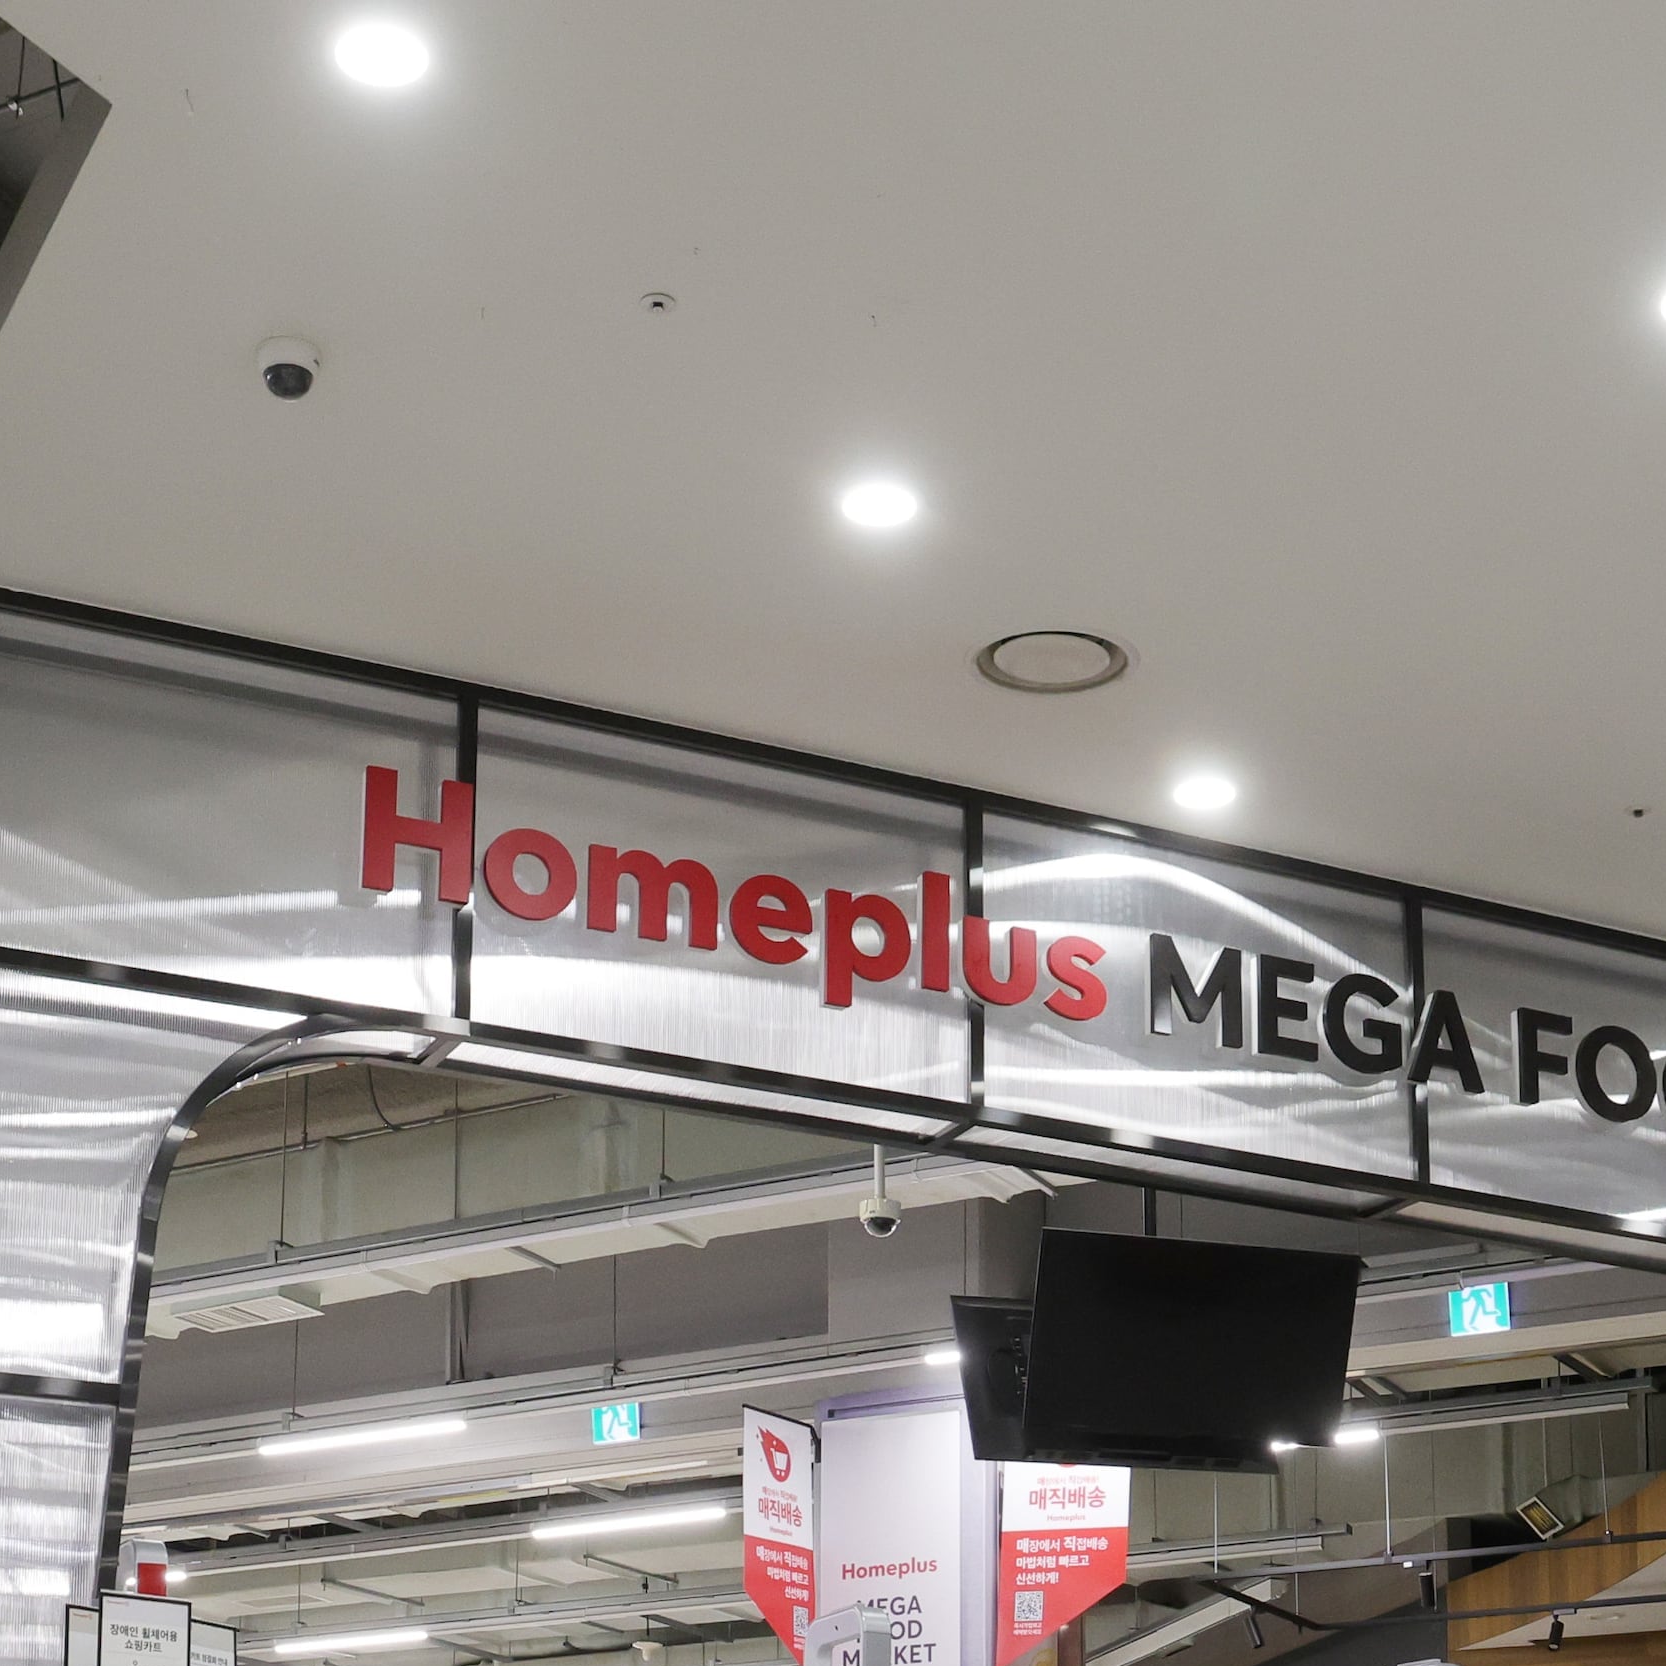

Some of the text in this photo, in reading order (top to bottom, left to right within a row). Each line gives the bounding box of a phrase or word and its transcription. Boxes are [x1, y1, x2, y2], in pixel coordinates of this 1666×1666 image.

[361, 764, 1109, 1022] Homeplus
[1144, 933, 1486, 1095] MEGA
[1028, 1485, 1106, 1511] 매직배송
[758, 1497, 802, 1527] 매직배송
[1016, 1536, 1108, 1553] 매장에서 직접배송
[841, 1557, 937, 1580] Homeplus
[1016, 1555, 1090, 1569] 마법처럼 빠르고
[1016, 1572, 1059, 1585] 신선하게!
[110, 1624, 178, 1642] 장애인 휠체어용
[124, 1640, 162, 1652] 쇼핑카트
